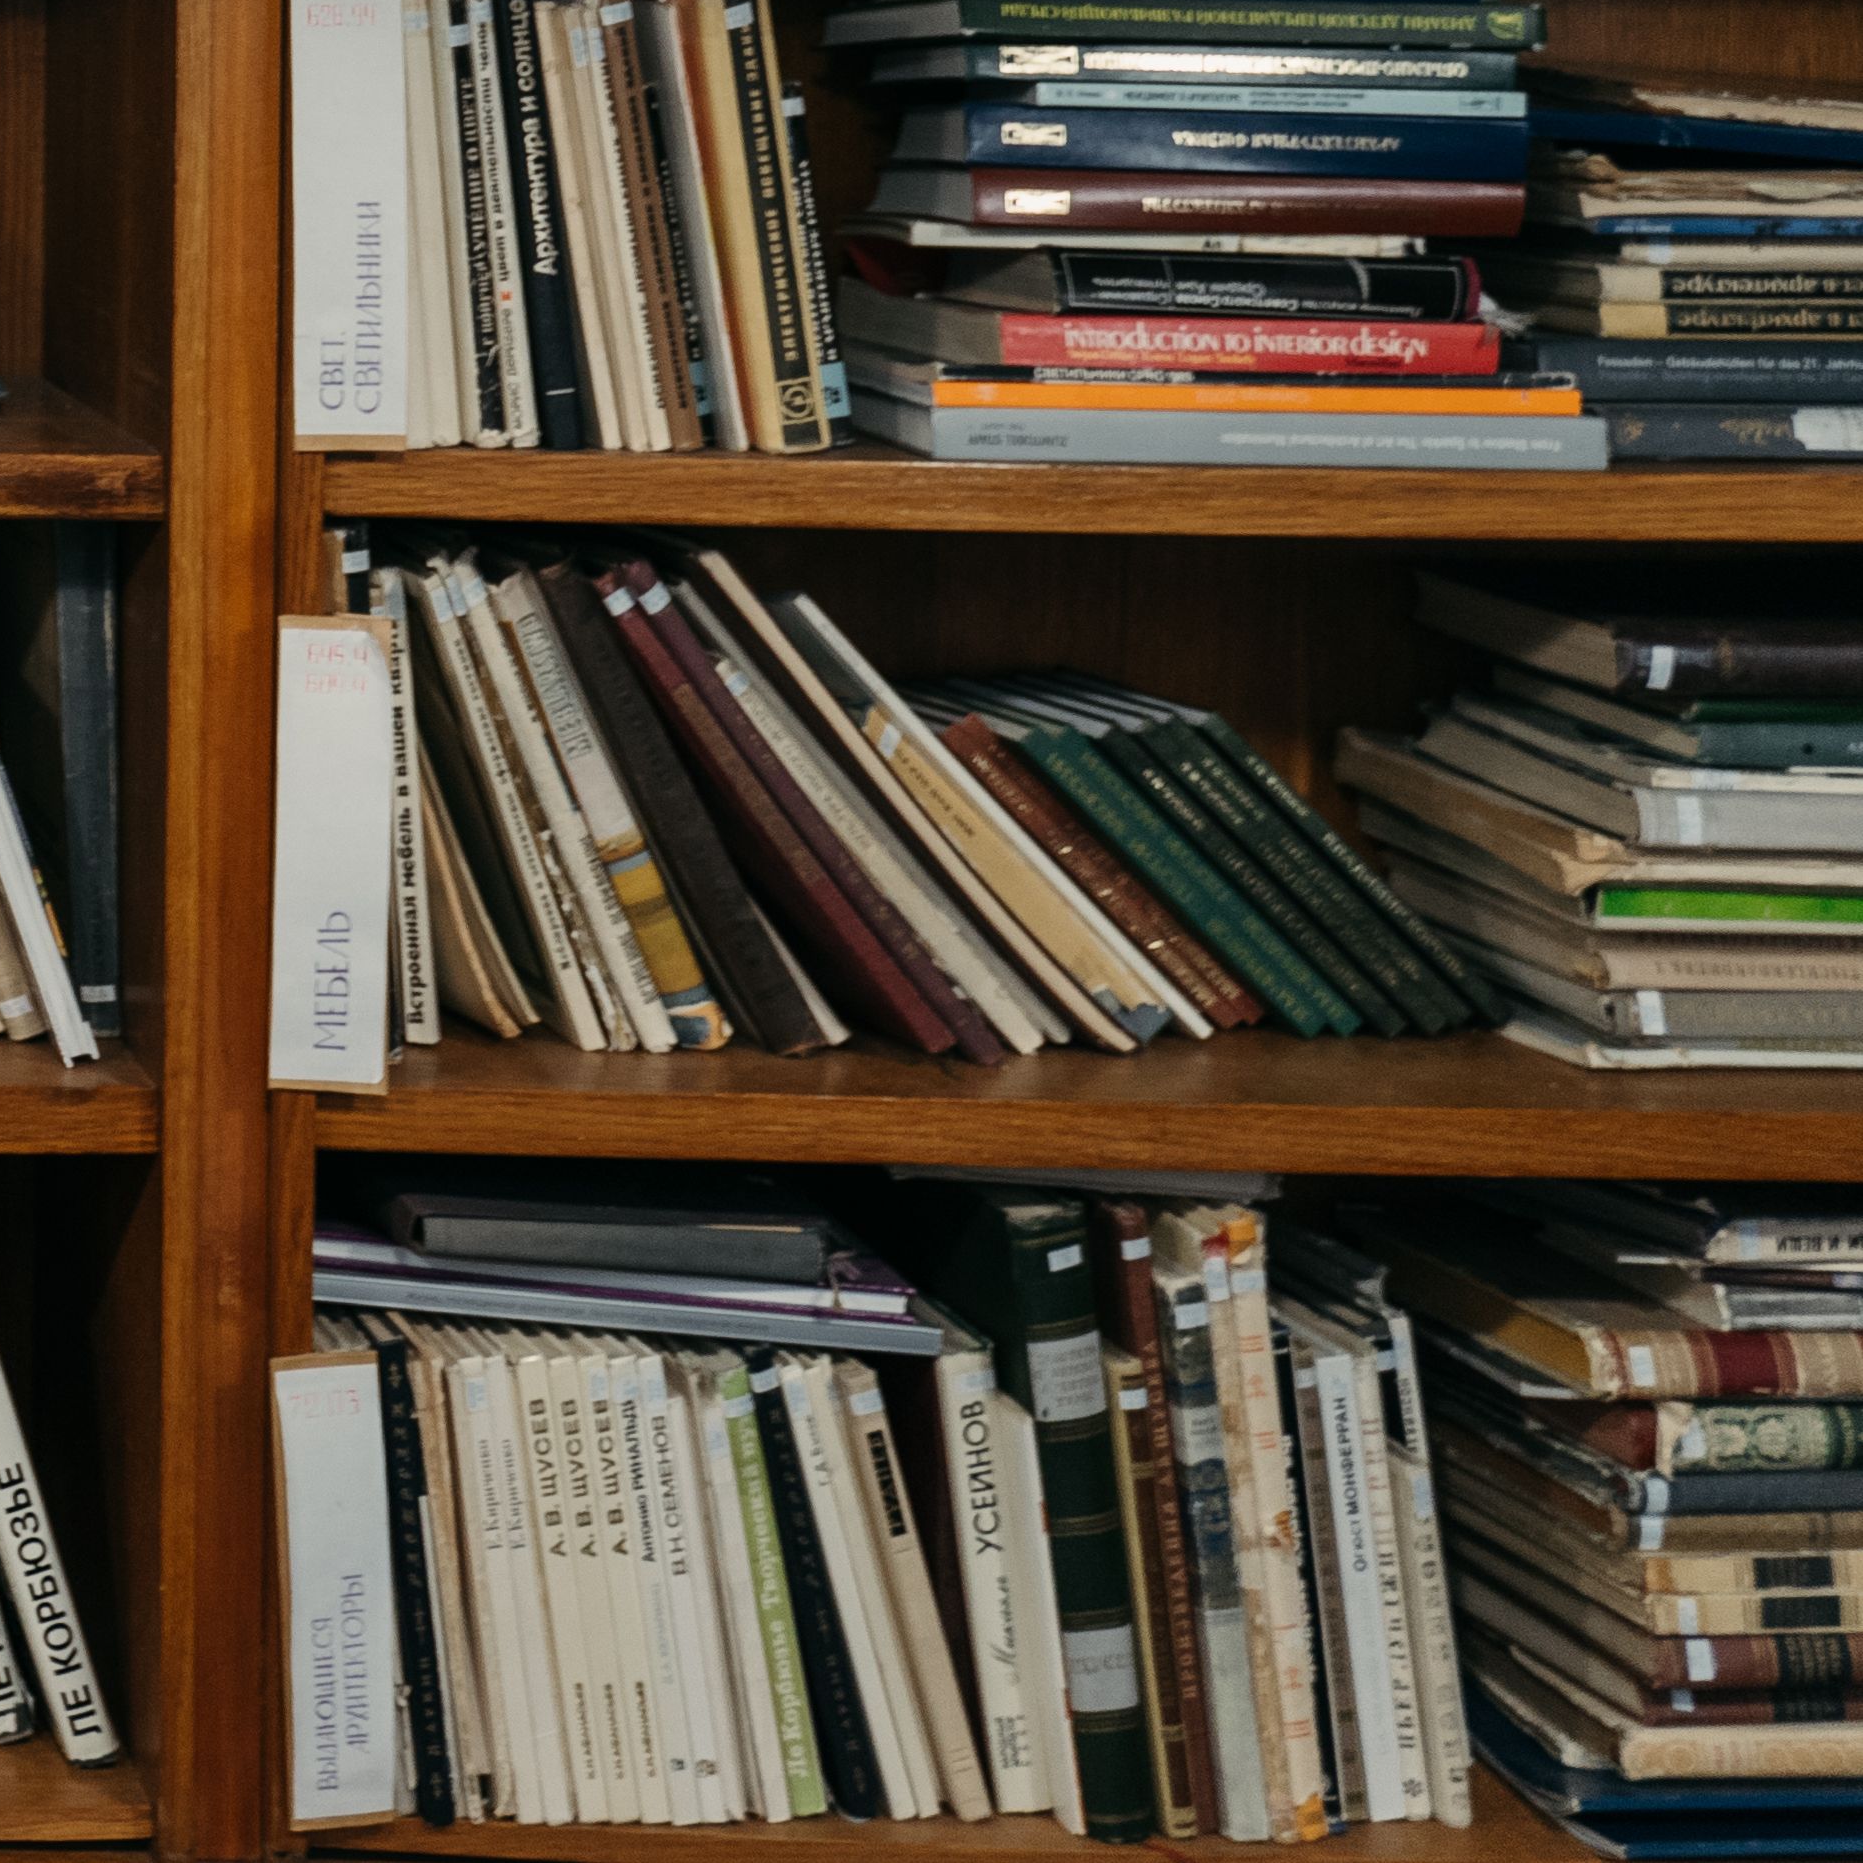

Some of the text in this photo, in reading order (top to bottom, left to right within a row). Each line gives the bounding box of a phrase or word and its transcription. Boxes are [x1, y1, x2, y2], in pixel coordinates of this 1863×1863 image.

[520, 96, 536, 111] и
[518, 116, 559, 276] Архитектура
[354, 201, 381, 413] СВЕТИЛЬНИКИ
[313, 911, 350, 1050] МЕБЕЛЬ
[526, 1397, 559, 1497] ЩУСЕВ
[58, 1682, 102, 1740] ЛЕ
[310, 1616, 340, 1791] ВЫДАЮЩИЕСЯ
[339, 1573, 370, 1752] АРХИТЕКТОРЫ
